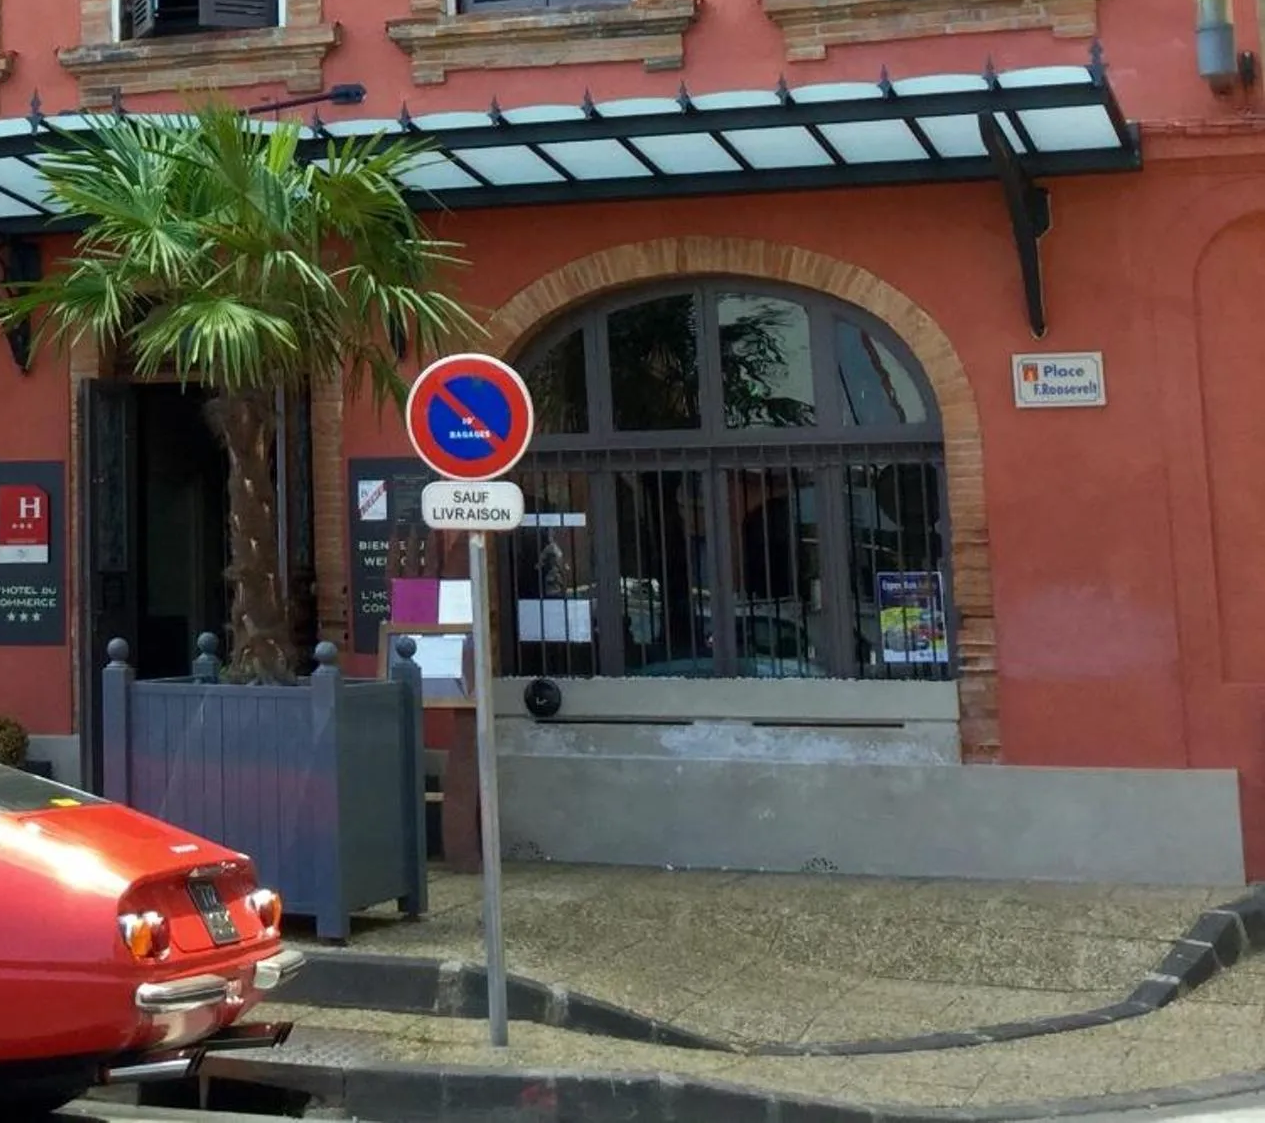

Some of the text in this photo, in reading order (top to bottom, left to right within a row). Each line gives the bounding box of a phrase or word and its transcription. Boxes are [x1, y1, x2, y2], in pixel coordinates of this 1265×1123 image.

[1043, 364, 1085, 377] Place
[448, 430, 491, 439] BAGAGES
[453, 491, 490, 504] SAUF
[20, 497, 41, 518] H
[432, 507, 511, 521] LIVRAISON
